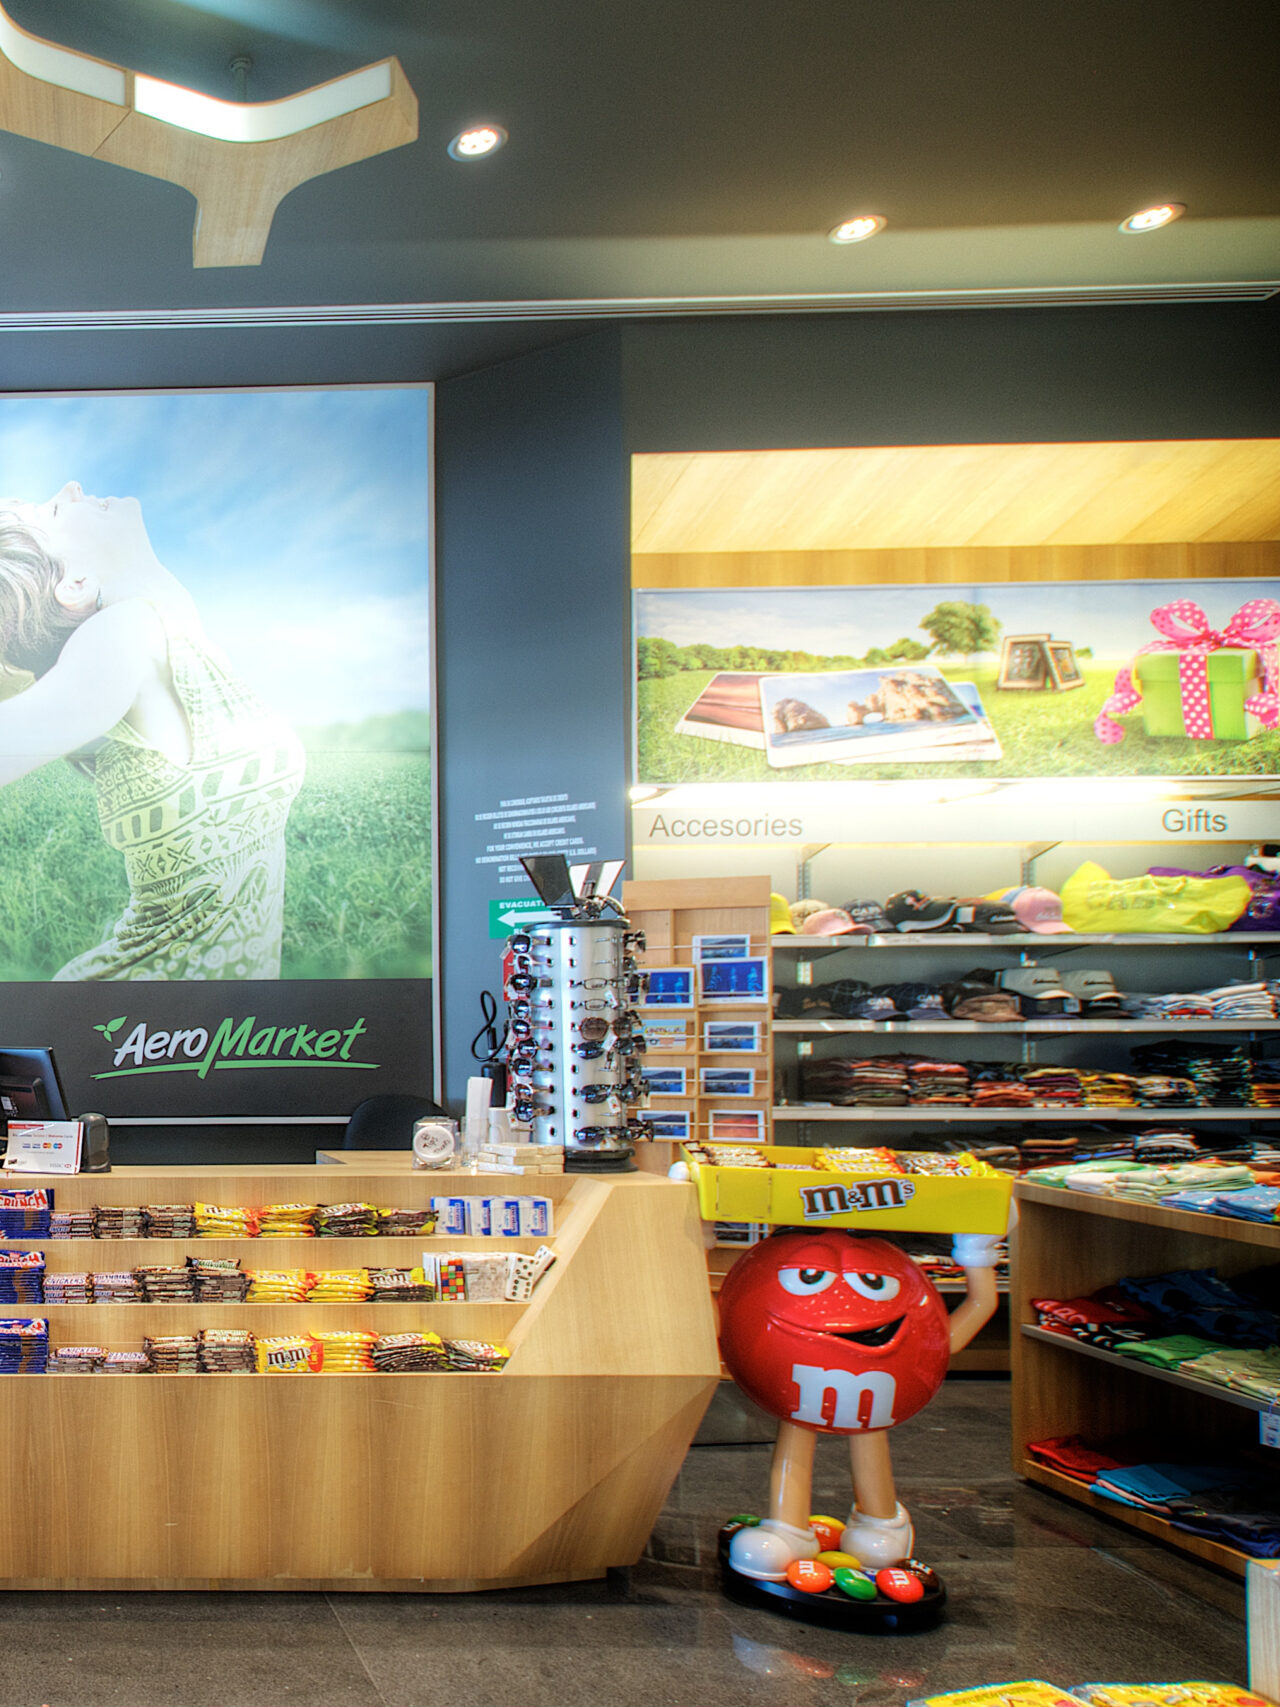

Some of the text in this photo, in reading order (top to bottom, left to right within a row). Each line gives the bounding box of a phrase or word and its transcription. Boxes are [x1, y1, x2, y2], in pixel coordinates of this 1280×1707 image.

[649, 812, 803, 838] Accesories
[1161, 807, 1228, 834] Gifts
[113, 1016, 368, 1080] AeroMarket
